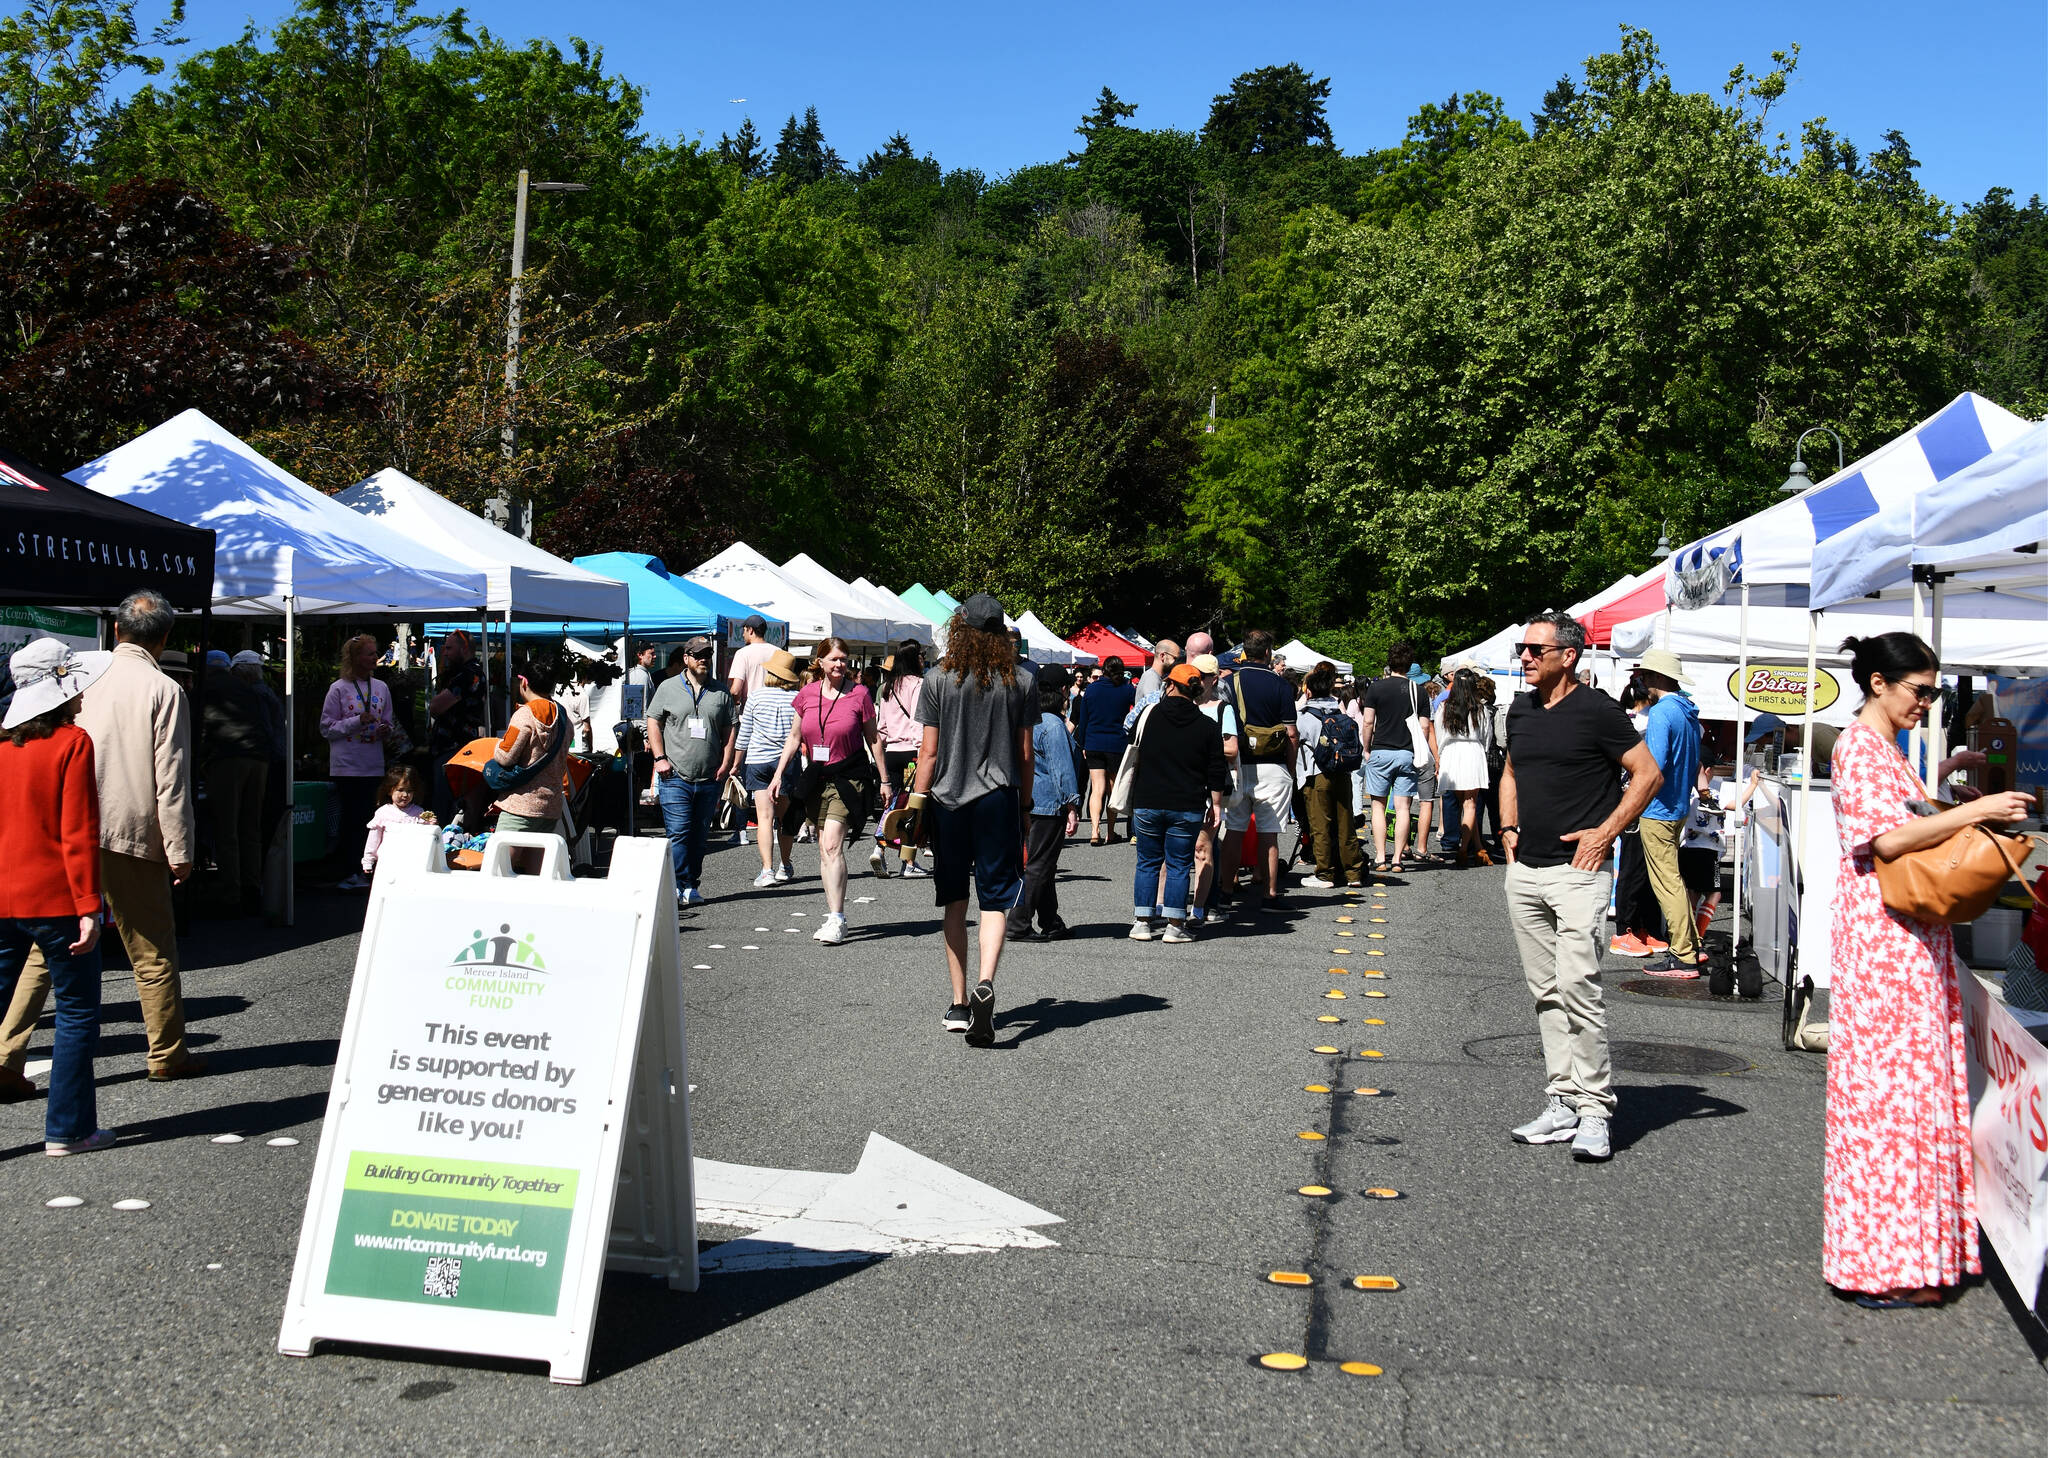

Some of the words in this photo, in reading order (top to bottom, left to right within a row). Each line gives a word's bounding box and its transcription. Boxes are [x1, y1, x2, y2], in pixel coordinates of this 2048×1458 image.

[1759, 696, 1779, 704] FIRST
[445, 977, 546, 996] COMMUNITY
[464, 967, 496, 978] Mercer
[499, 969, 529, 980] Island
[469, 994, 514, 1010] FUND
[425, 1022, 478, 1046] This
[483, 1031, 551, 1051] event
[389, 1049, 411, 1071] is
[416, 1055, 540, 1081] supported
[544, 1061, 576, 1088] by
[377, 1083, 486, 1107] generous
[491, 1088, 577, 1115] donors
[417, 1111, 465, 1135] like
[468, 1119, 524, 1142] you!
[364, 1164, 419, 1185] Building
[421, 1169, 500, 1191] Community
[502, 1175, 565, 1194] Together
[390, 1208, 459, 1232] DONATE
[461, 1215, 519, 1238] TODAY
[354, 1233, 548, 1267] www.micommunityfund.org
